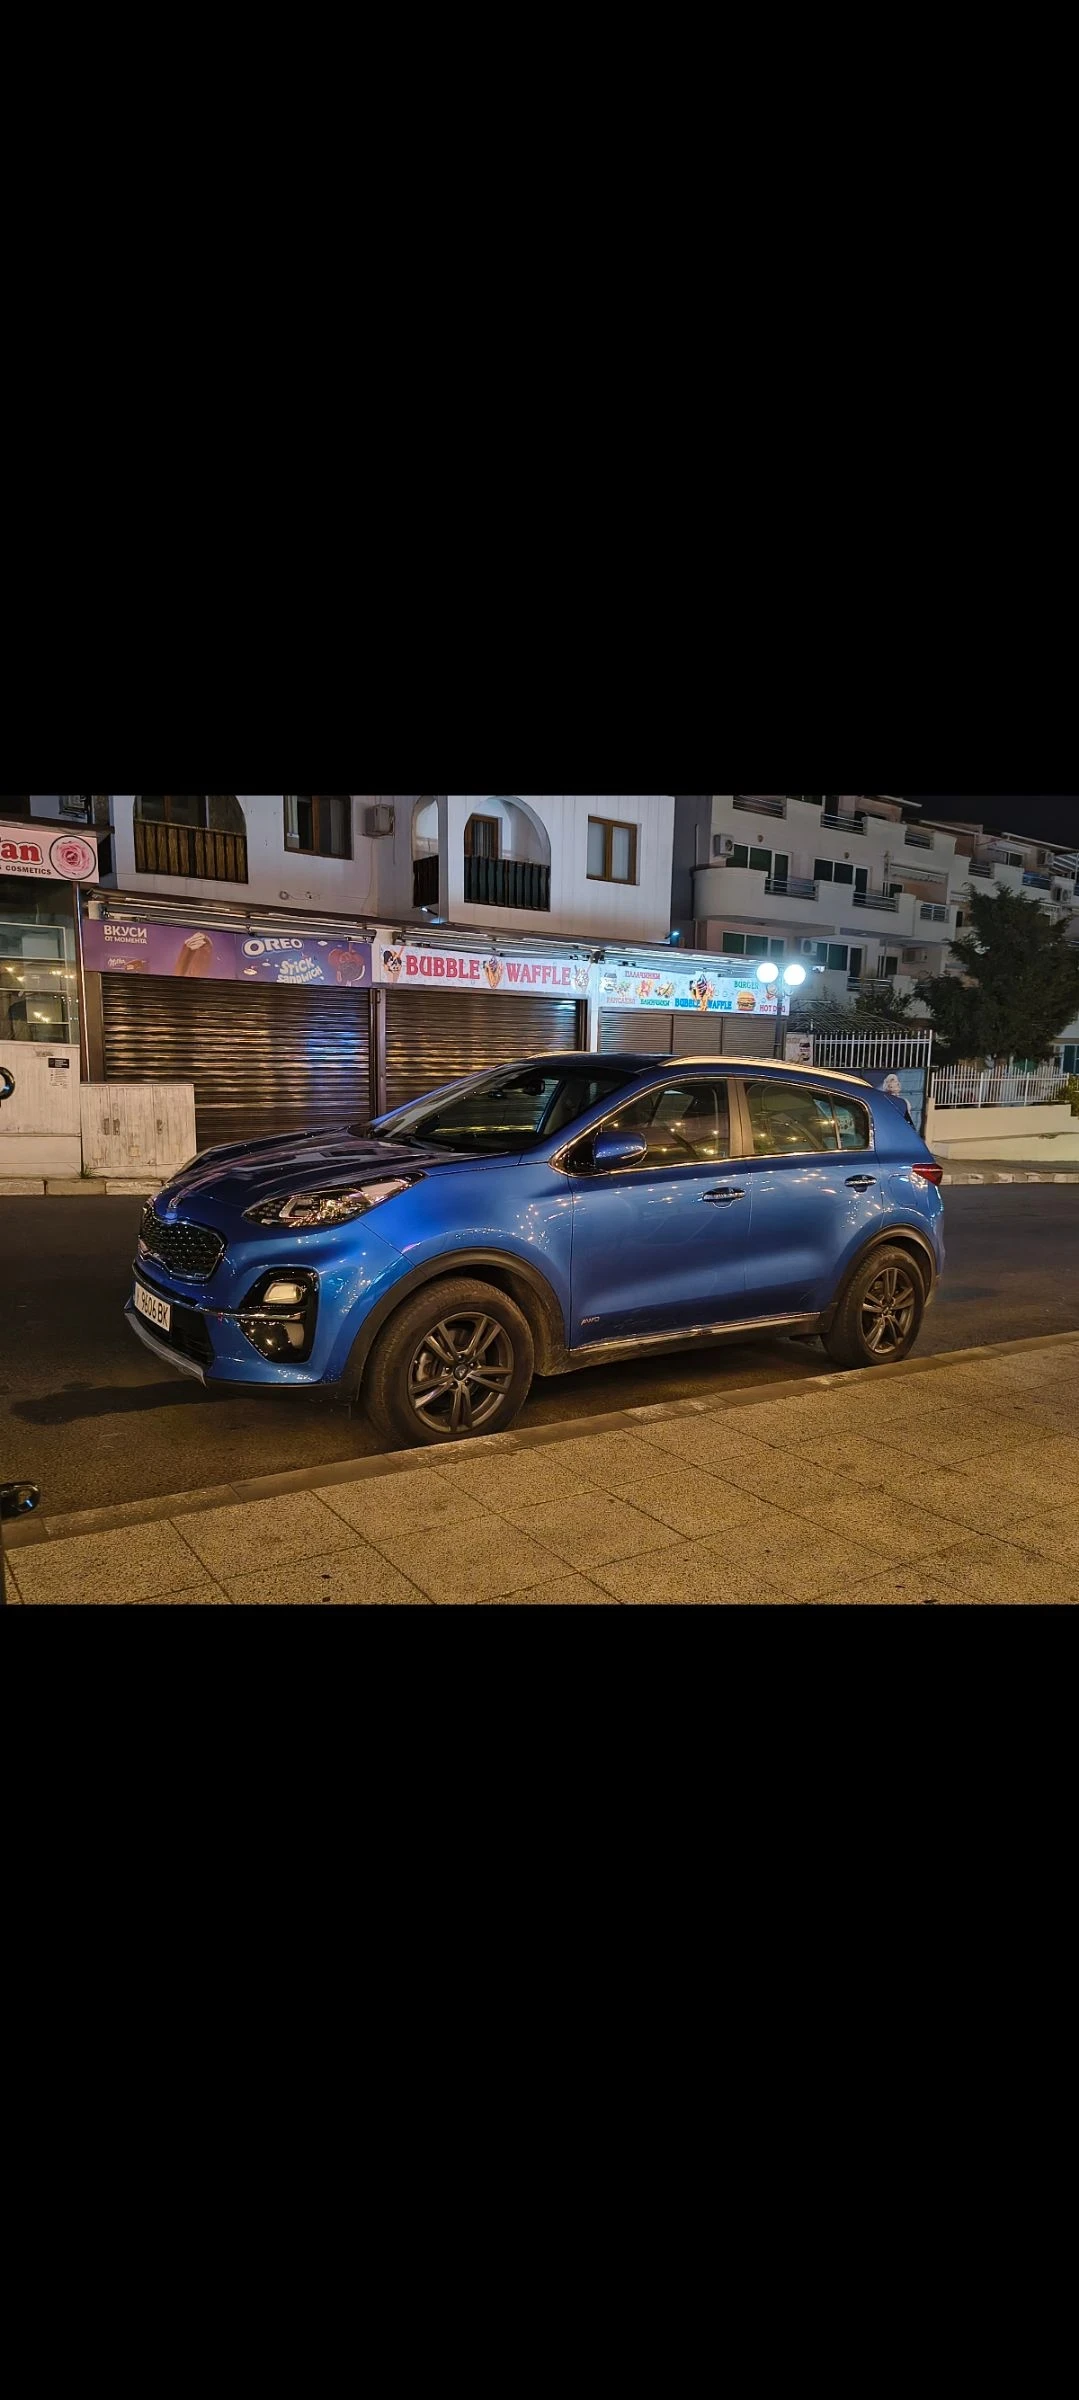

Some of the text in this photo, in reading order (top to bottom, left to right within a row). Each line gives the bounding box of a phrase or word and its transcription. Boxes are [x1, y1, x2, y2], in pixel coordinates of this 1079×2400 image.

[0, 841, 42, 863] an
[5, 865, 52, 876] COSMETICS
[103, 924, 148, 938] ВКУСИ
[114, 936, 148, 944] МОМЕНТА
[243, 938, 304, 957] OREO
[405, 954, 572, 986] BUBBLE WAFFLE
[734, 980, 759, 990] BURGER
[674, 998, 733, 1010] BUBBLE WAFFLE
[759, 1004, 786, 1013] HOT DG
